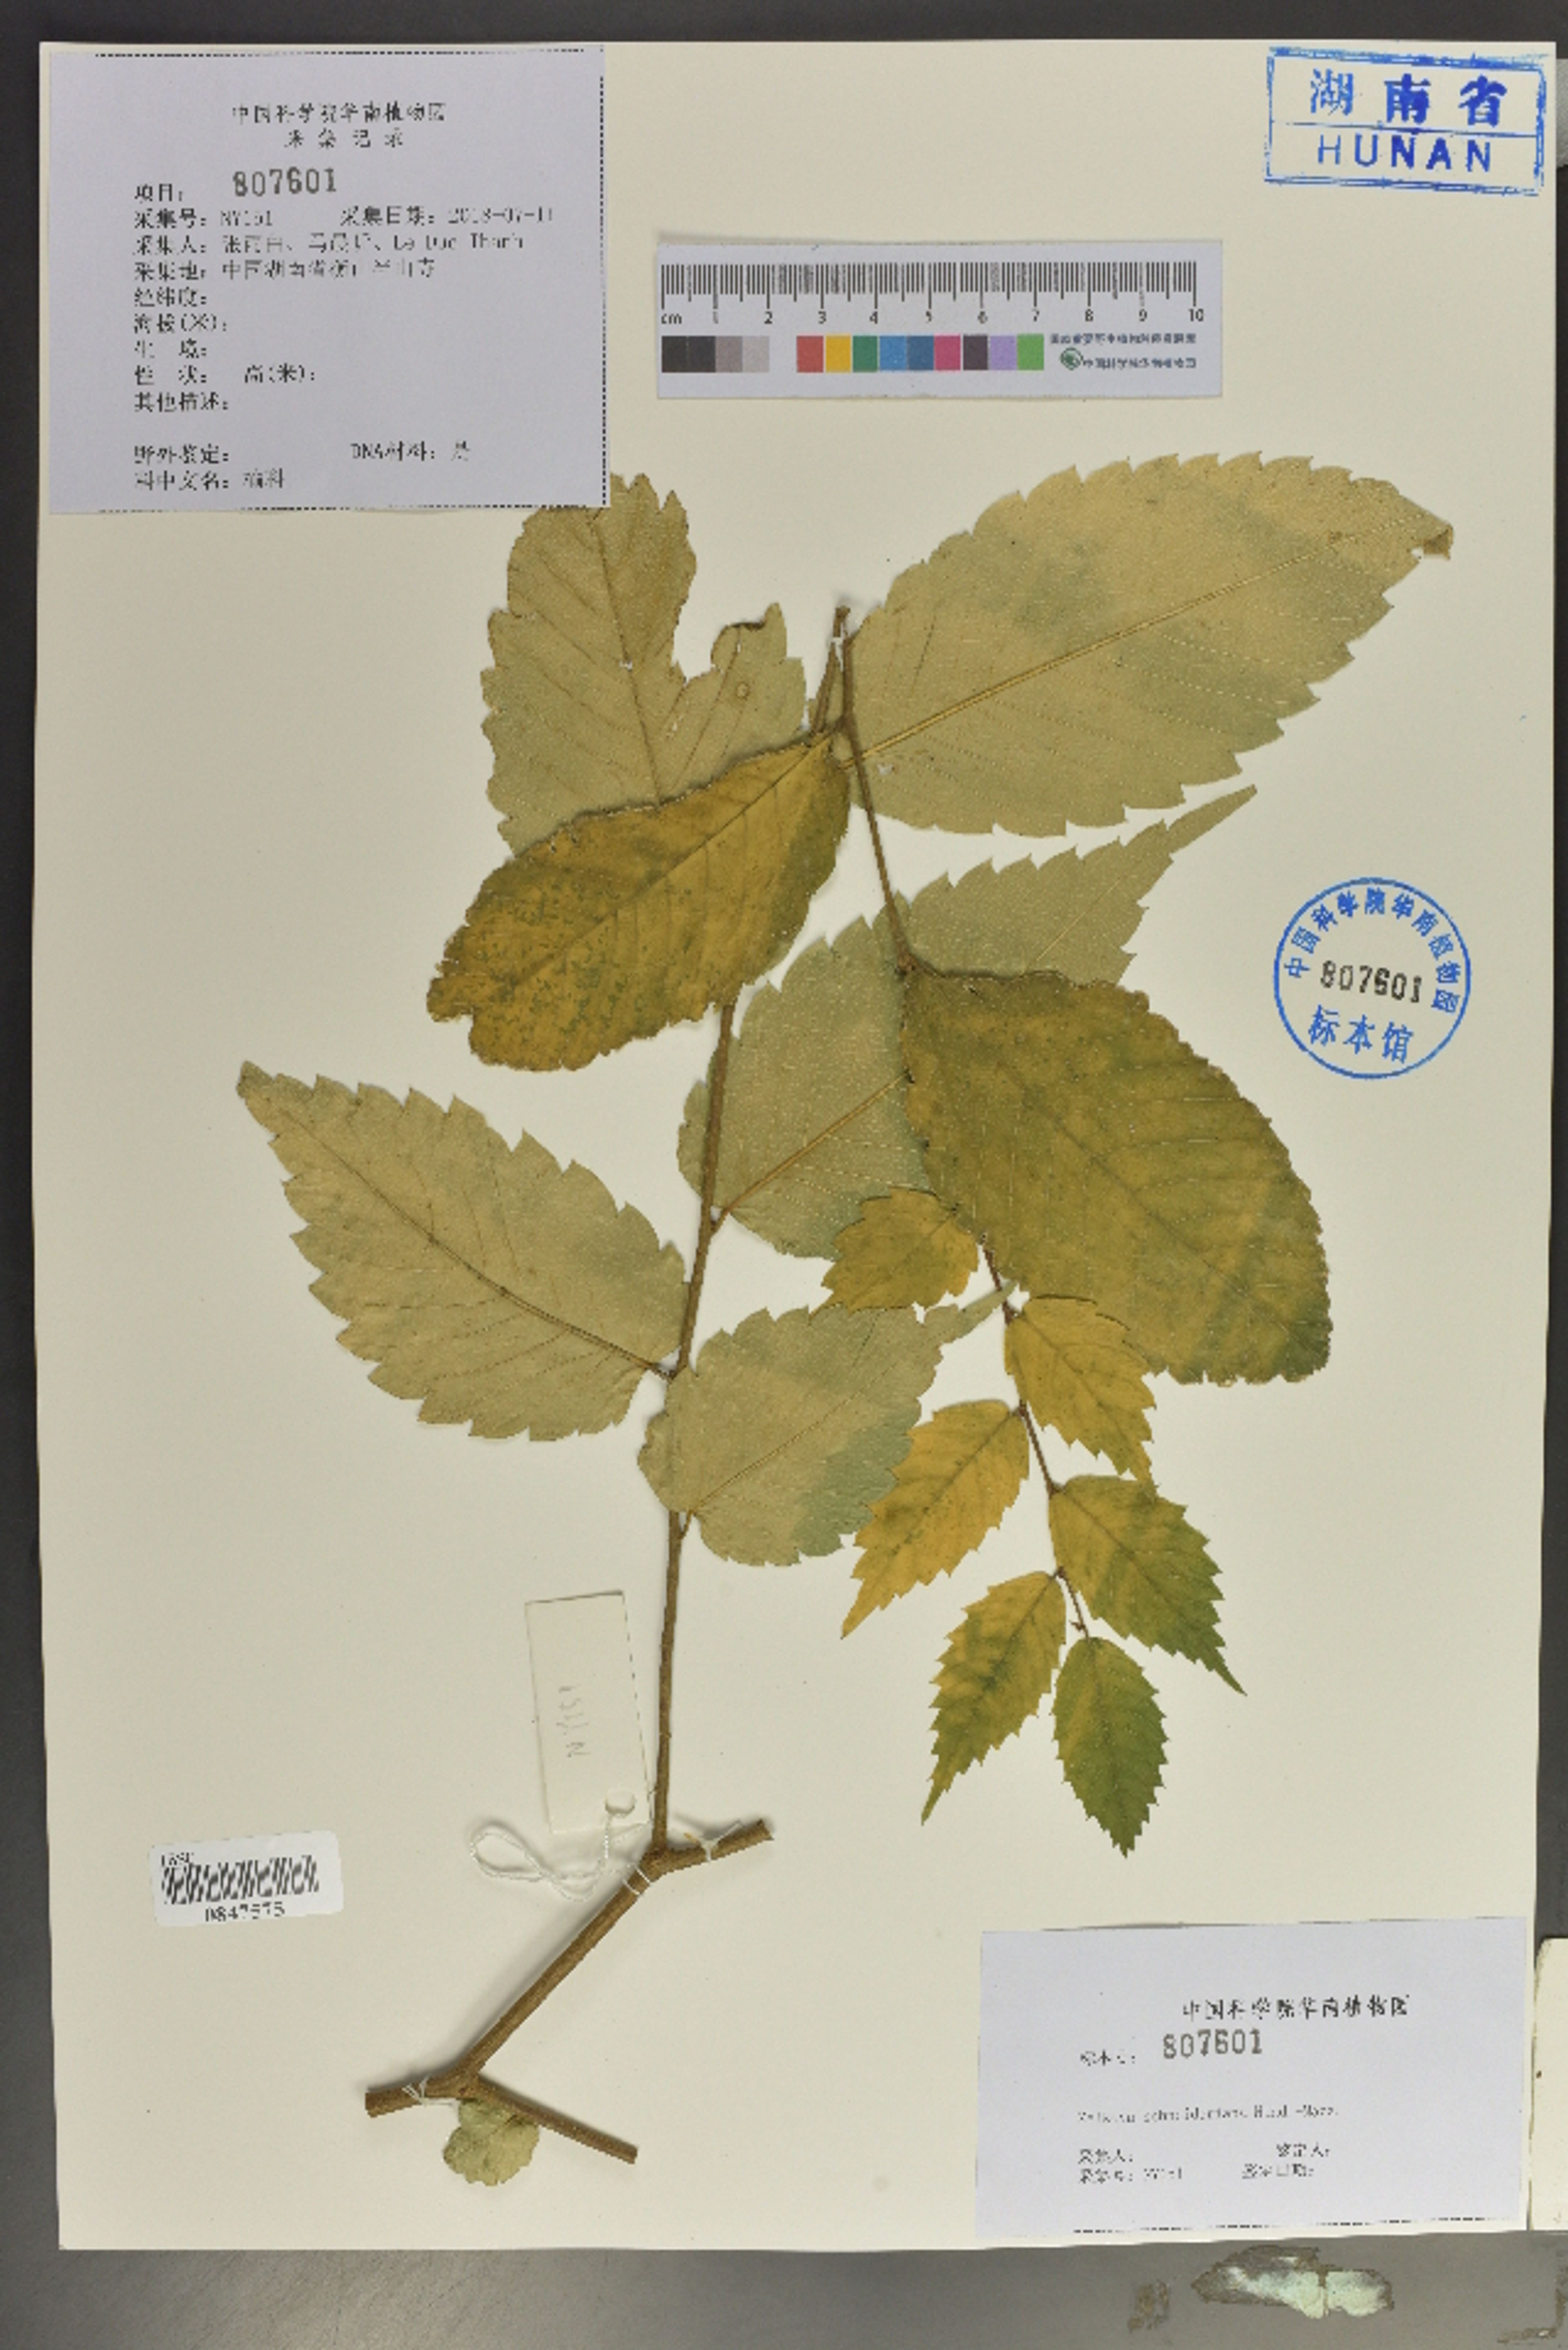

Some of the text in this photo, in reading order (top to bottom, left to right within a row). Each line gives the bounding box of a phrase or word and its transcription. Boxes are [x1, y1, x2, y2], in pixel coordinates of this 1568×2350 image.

[1309, 67, 1507, 127] 湖南省
[1318, 133, 1491, 172] HUNAN
[233, 167, 336, 197] 807601
[764, 311, 773, 325] 2
[818, 311, 827, 325] 3
[869, 311, 878, 325] 4
[1321, 960, 1422, 1003] 807601
[1307, 1004, 1414, 1064] 标本馆
